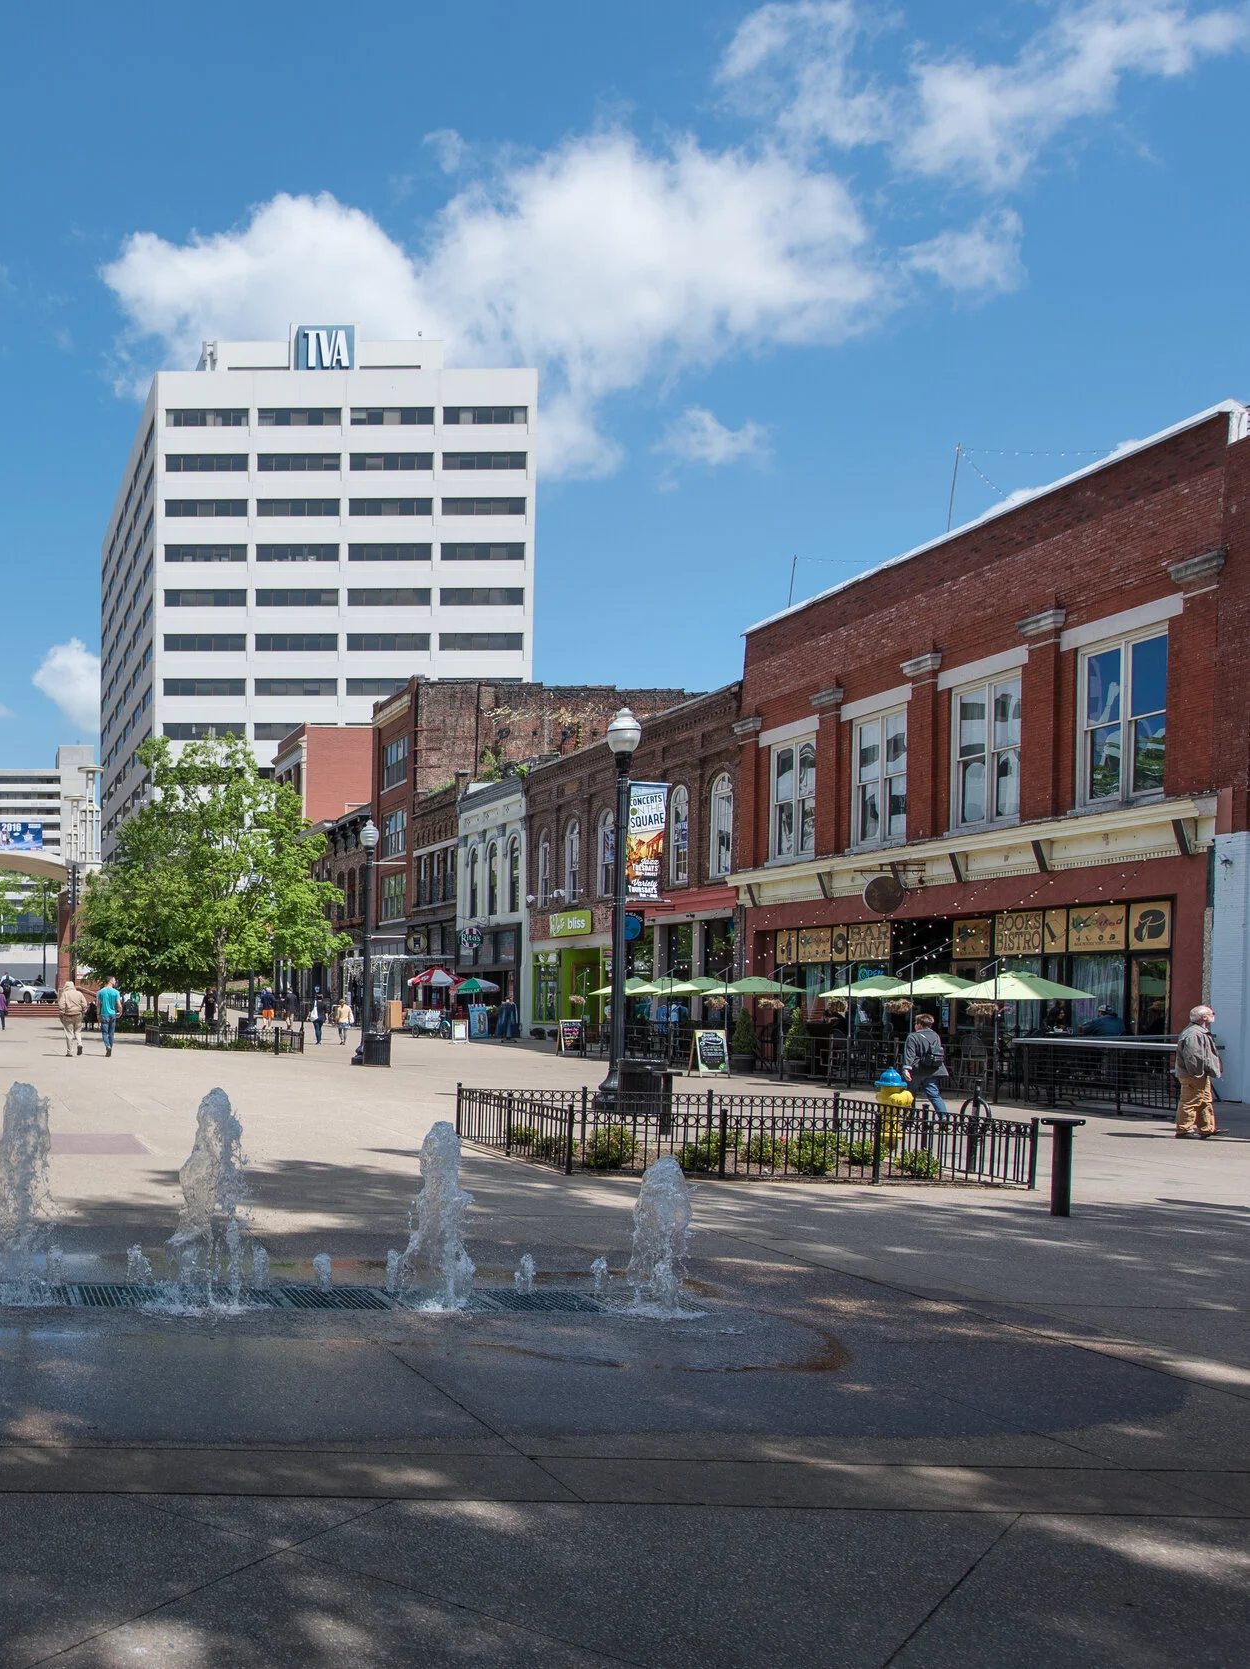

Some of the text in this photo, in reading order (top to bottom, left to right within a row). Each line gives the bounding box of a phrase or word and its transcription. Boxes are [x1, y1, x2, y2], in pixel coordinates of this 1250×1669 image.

[303, 330, 350, 368] TVA
[630, 794, 662, 806] CONCERTS
[647, 803, 662, 814] THE
[630, 812, 665, 829] SQUARE
[2, 823, 22, 832] 2016
[631, 863, 658, 872] TUESDAYS
[627, 885, 658, 893] THURSDAYS
[631, 879, 658, 889] Variety
[567, 916, 586, 930] bliss
[996, 913, 1042, 932] BOOKS
[461, 934, 481, 942] Rita's
[850, 923, 889, 941] BAR
[996, 929, 1041, 951] BISTRO
[849, 941, 888, 959] VINYL
[858, 968, 884, 981] OPEN
